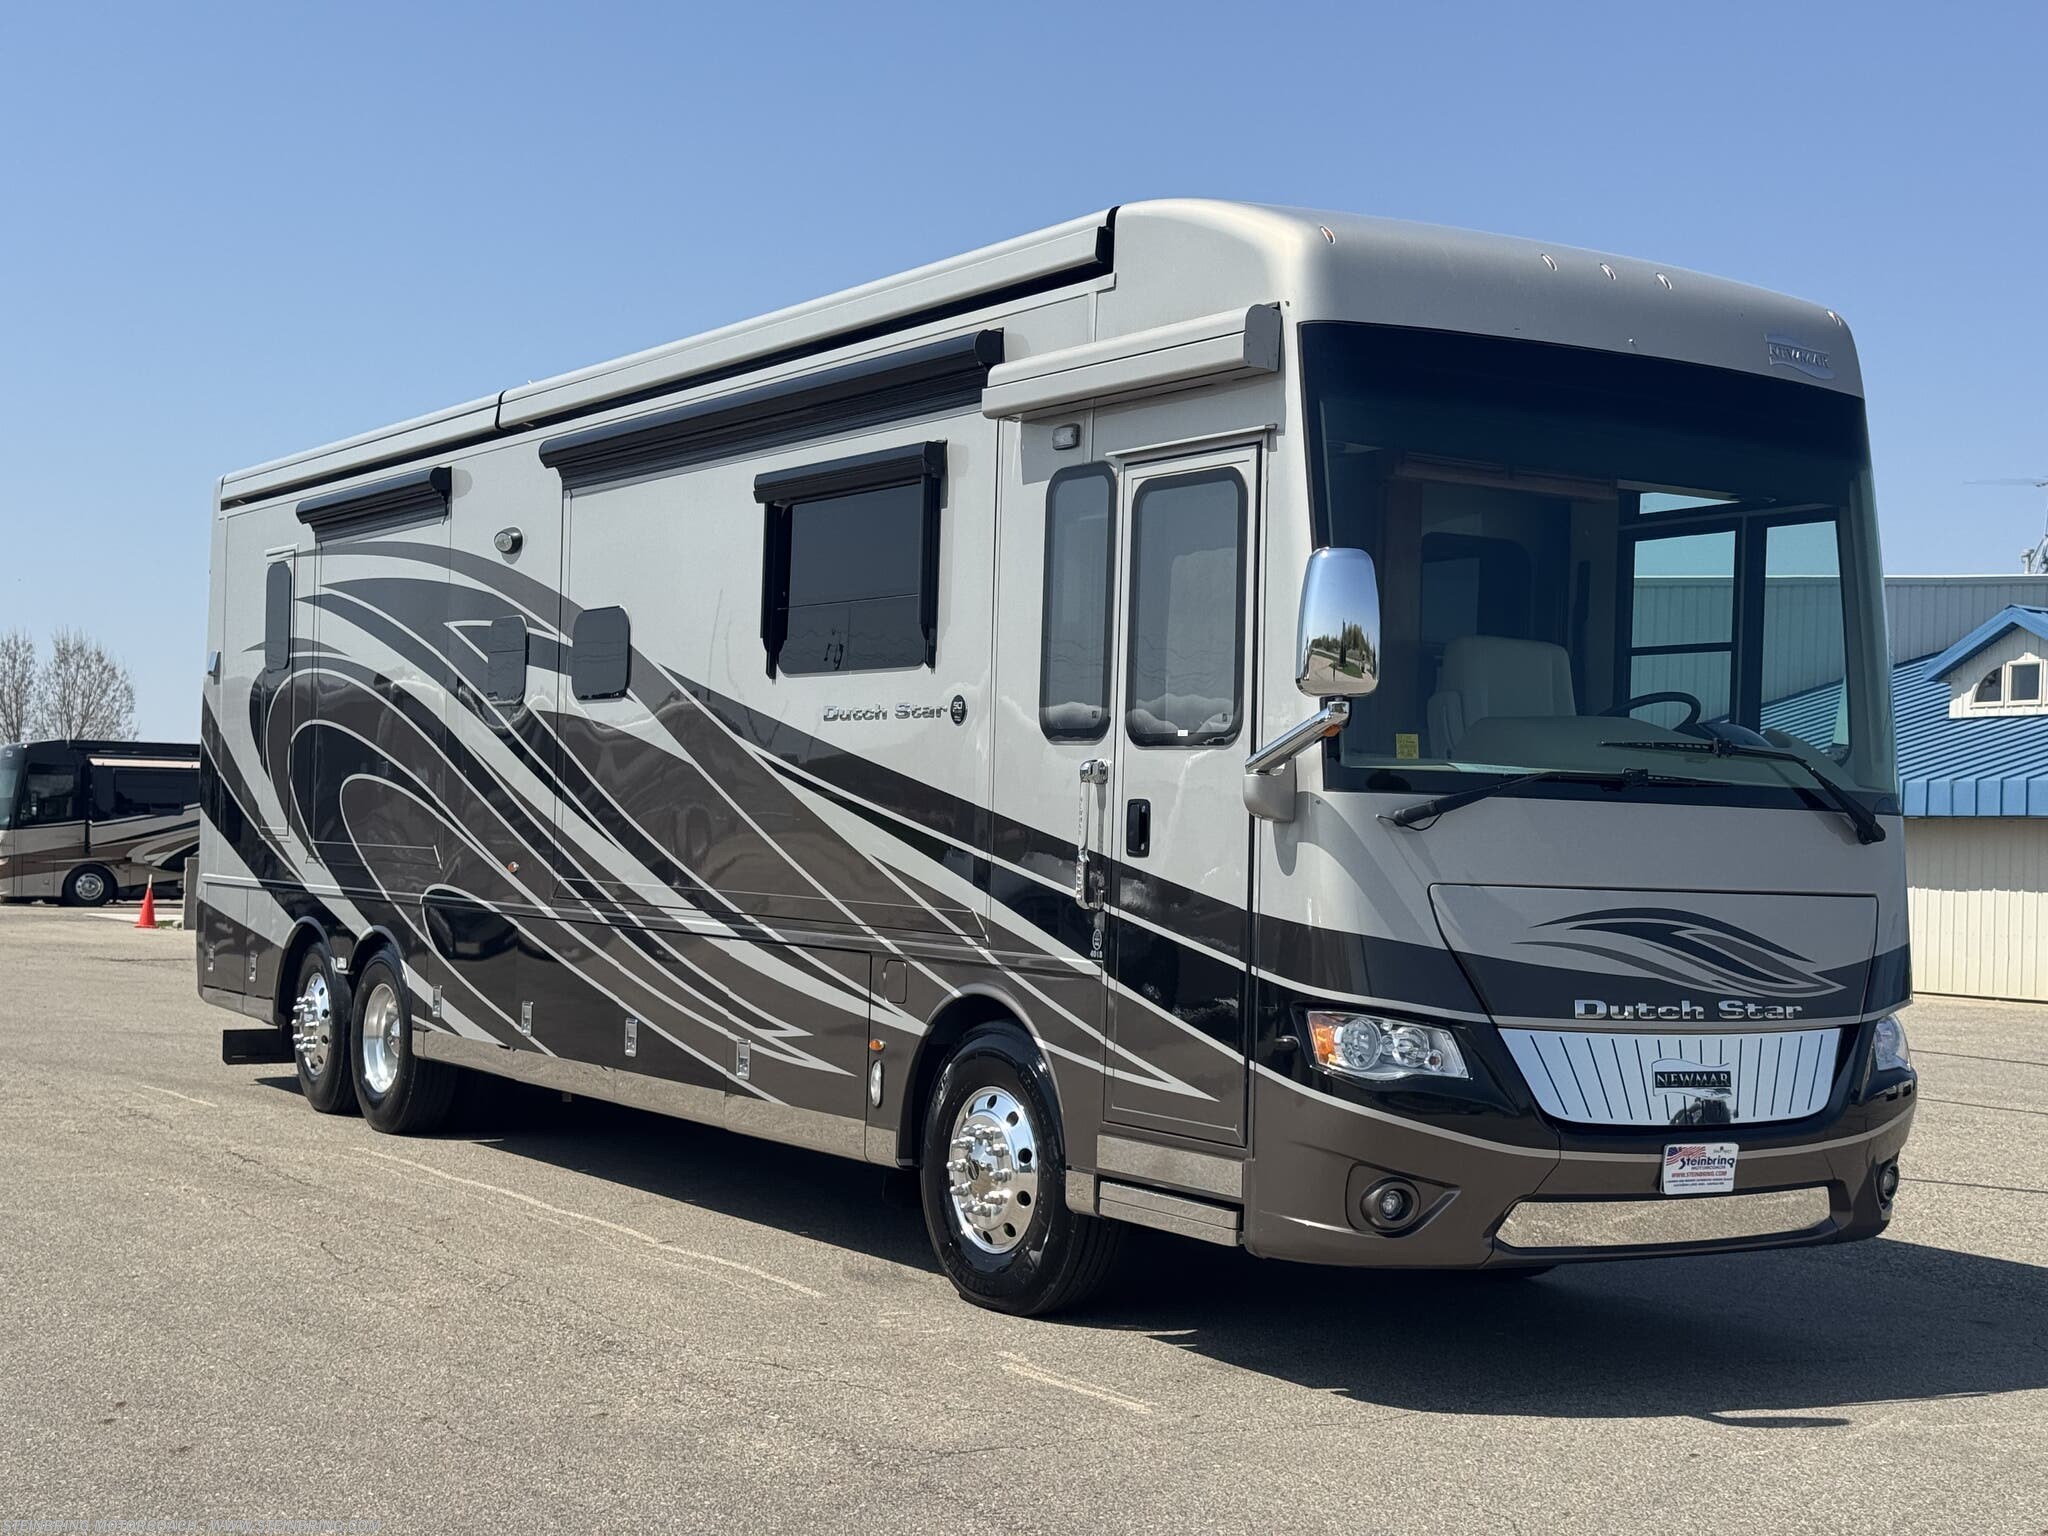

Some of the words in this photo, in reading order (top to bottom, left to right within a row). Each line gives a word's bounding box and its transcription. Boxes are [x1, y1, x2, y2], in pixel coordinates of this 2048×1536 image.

[823, 704, 888, 722] Dutch
[895, 701, 948, 720] Star
[1574, 999, 1705, 1020] Dutch
[1718, 999, 1804, 1020] Star
[1656, 1072, 1730, 1087] NEWMAR
[1679, 1155, 1735, 1170] Steinbring
